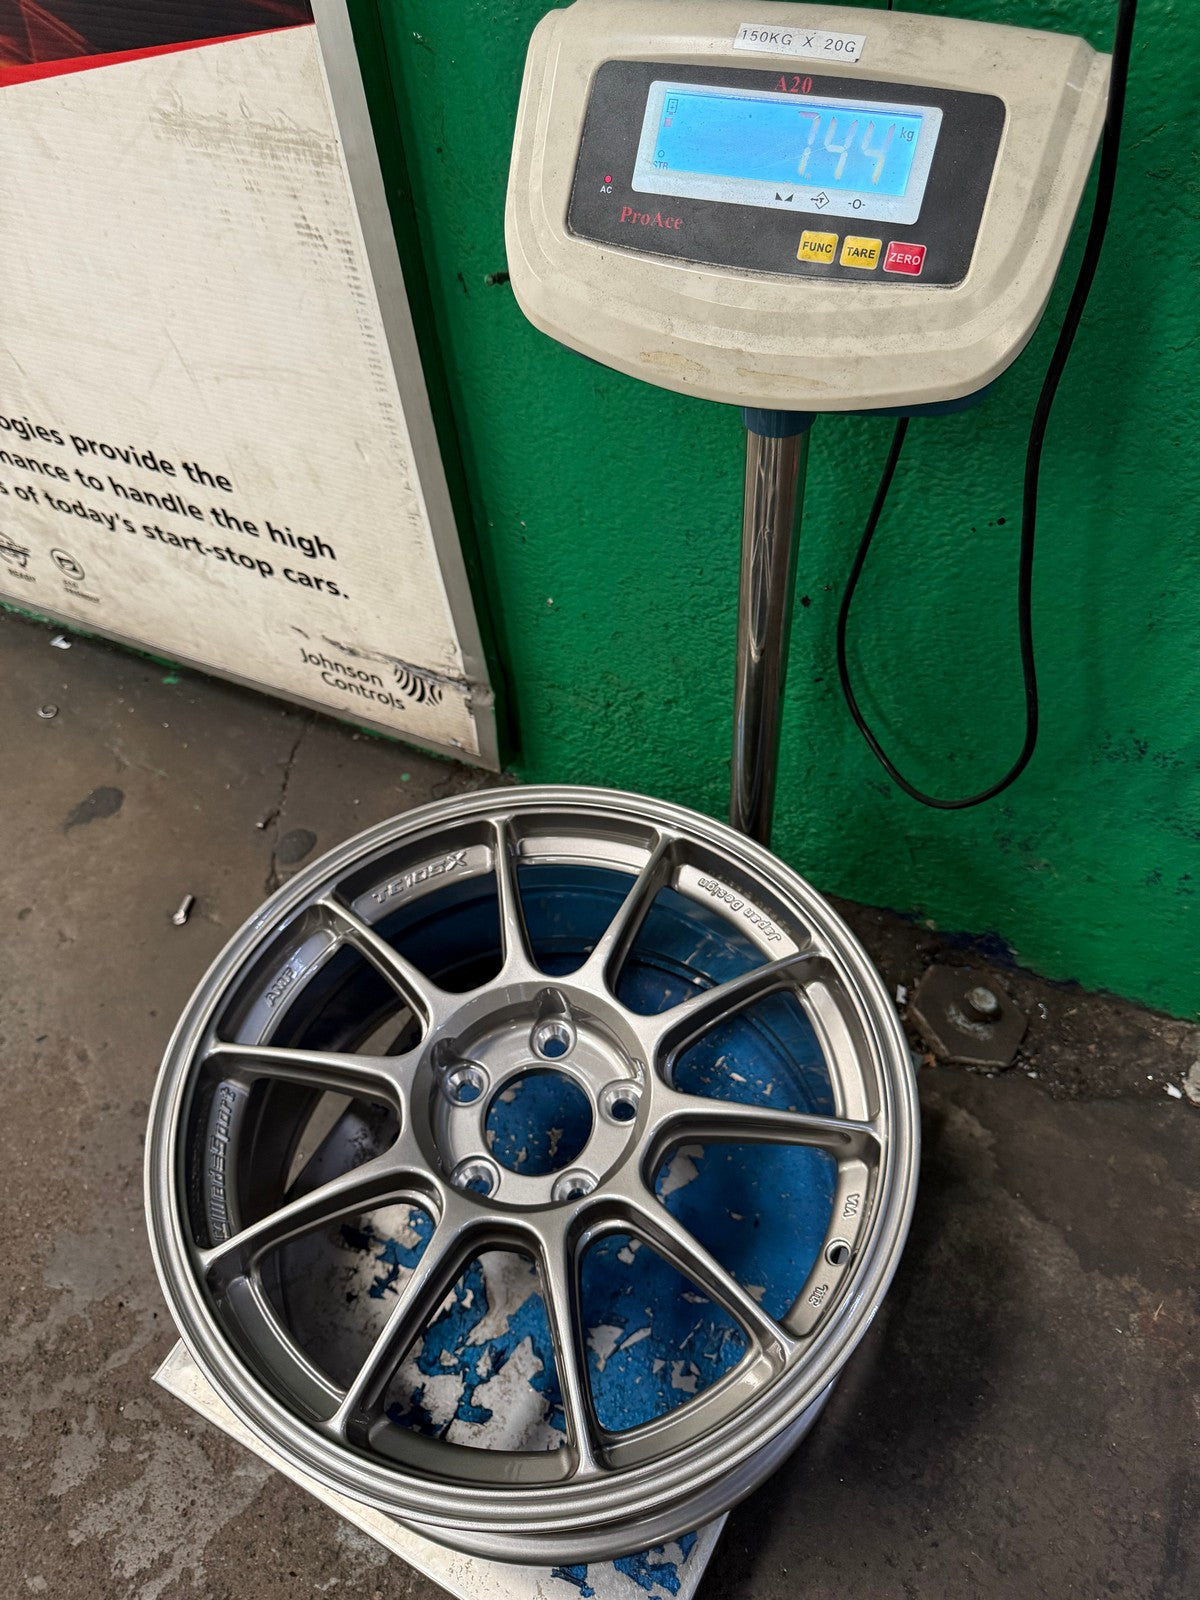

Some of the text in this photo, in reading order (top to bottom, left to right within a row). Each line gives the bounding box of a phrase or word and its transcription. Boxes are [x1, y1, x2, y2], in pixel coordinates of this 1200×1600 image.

[742, 29, 856, 53] 150KG X 20G
[774, 74, 813, 94] A20
[899, 127, 915, 142] kg
[599, 184, 613, 194] AC
[619, 206, 684, 230] ProAce
[802, 241, 833, 254] FUNC
[846, 246, 877, 259] TARE
[888, 252, 921, 266] ZERO
[0, 415, 234, 493] ogies provide the
[74, 468, 105, 492] to
[107, 475, 205, 521] handle
[210, 507, 260, 538] the
[265, 520, 337, 561] high
[14, 485, 40, 506] of
[44, 489, 137, 533] today's
[142, 523, 275, 579] start-stop
[283, 568, 350, 600] cars.
[300, 648, 384, 688] Johnson
[321, 671, 406, 711] Controls
[697, 876, 782, 942] Japan Design
